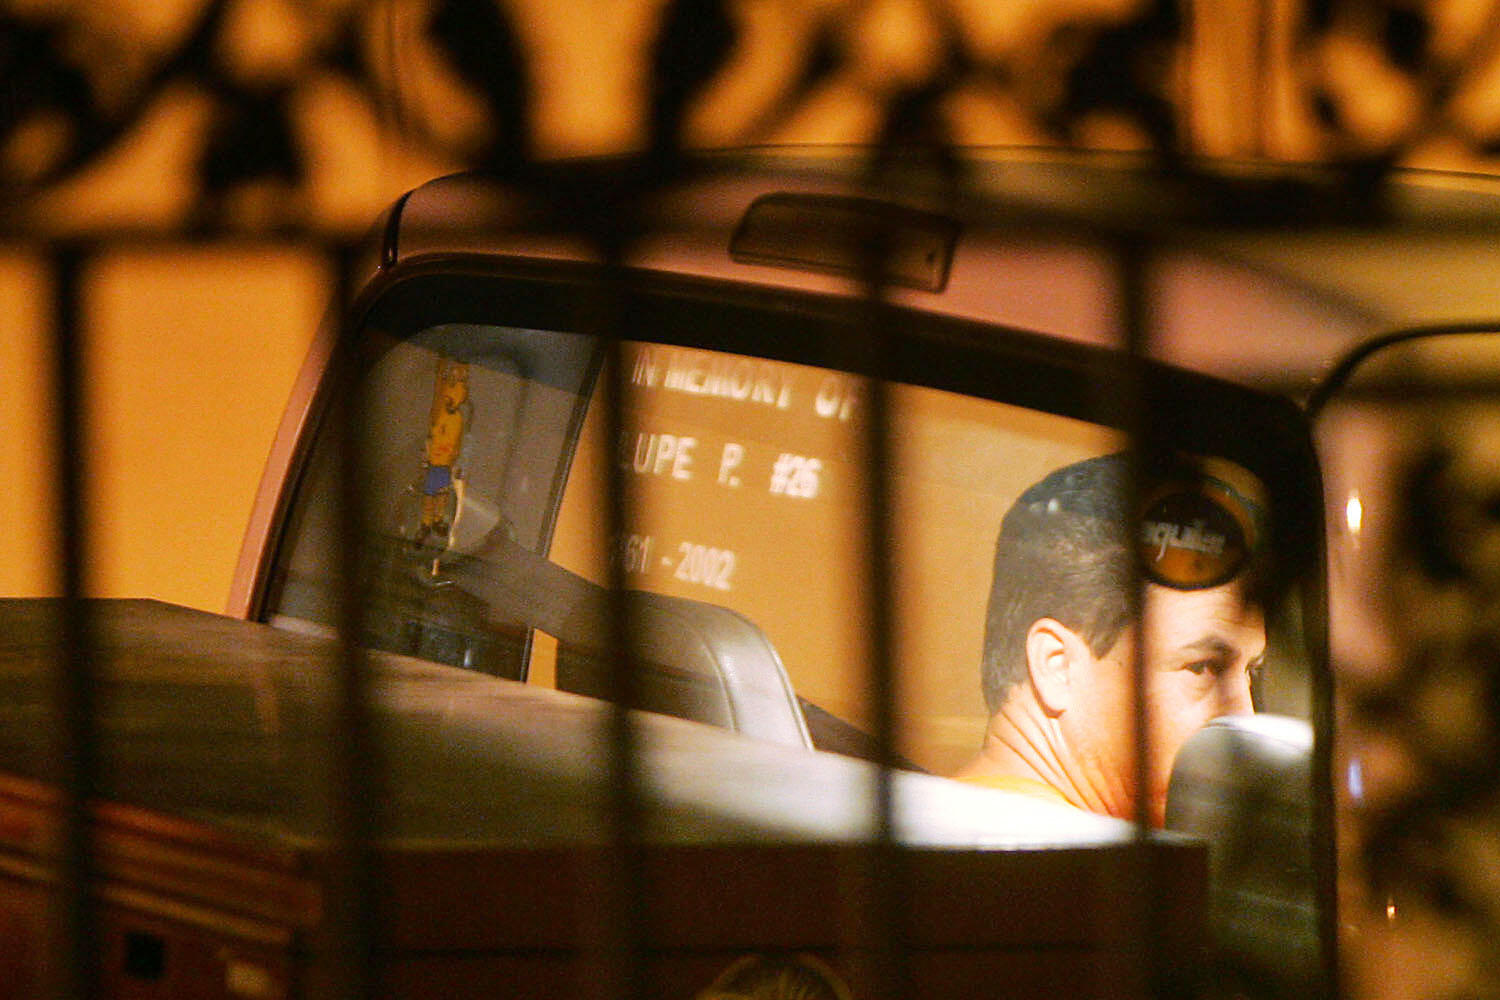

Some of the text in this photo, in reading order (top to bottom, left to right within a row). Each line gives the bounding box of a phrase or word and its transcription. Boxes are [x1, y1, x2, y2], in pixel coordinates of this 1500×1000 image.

[632, 347, 656, 387] IN
[664, 351, 794, 411] MEMORY
[717, 442, 745, 487] P.
[674, 541, 736, 591] 2002
